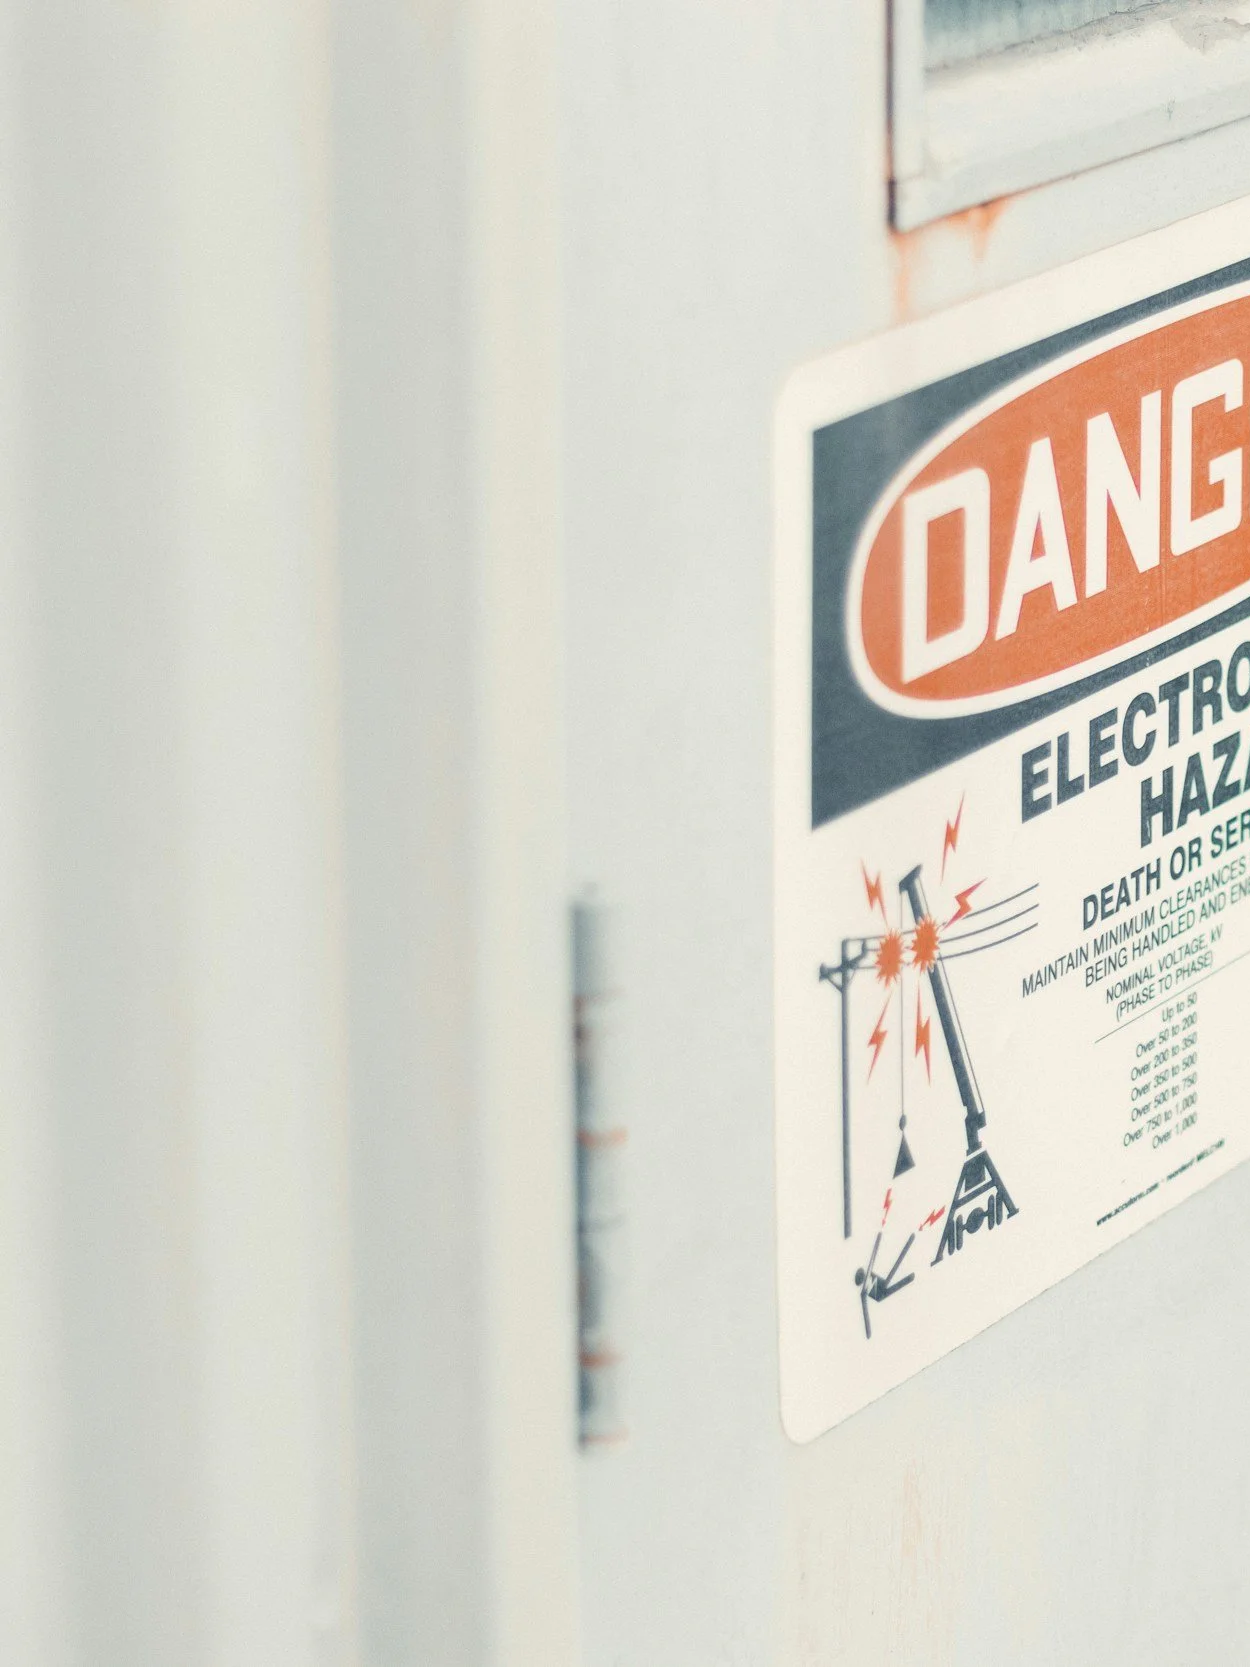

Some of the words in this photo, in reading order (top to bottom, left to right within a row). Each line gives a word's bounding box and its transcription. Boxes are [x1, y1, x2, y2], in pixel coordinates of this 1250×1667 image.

[1083, 857, 1161, 931] DEATH
[1169, 836, 1202, 881] OR
[1022, 942, 1089, 998] MAINTAIN
[1093, 906, 1155, 958] MINIMUM
[1159, 855, 1246, 920] CLEARANCES
[1085, 947, 1128, 988] BEING
[1132, 909, 1196, 961] HANDLED
[1199, 891, 1227, 923] AND
[1106, 964, 1156, 1004] NOMINAL
[1158, 932, 1208, 973] VOLTAGE,
[1116, 983, 1155, 1022] (PHASE
[1158, 973, 1173, 994] TO
[1175, 950, 1213, 985] PHASE)
[1161, 1007, 1174, 1023] Up
[1176, 1001, 1185, 1014] to
[1187, 992, 1197, 1008] 50
[1136, 1038, 1156, 1058] Over
[1158, 1028, 1169, 1045] 50
[1171, 1024, 1180, 1037] to
[1182, 1011, 1197, 1031] 200
[1131, 1061, 1151, 1081] Over
[1154, 1049, 1169, 1068] 200
[1171, 1044, 1180, 1057] to
[1131, 1082, 1151, 1101] Over
[1171, 1064, 1180, 1077] to
[1182, 1051, 1197, 1071] 500
[1131, 1102, 1151, 1122] Over
[1154, 1089, 1169, 1109] 500
[1171, 1084, 1180, 1097] to
[1182, 1071, 1197, 1091] 750
[1123, 1127, 1143, 1147] Over
[1146, 1113, 1162, 1132] 750
[1164, 1108, 1173, 1121] to
[1152, 1129, 1172, 1149] Over
